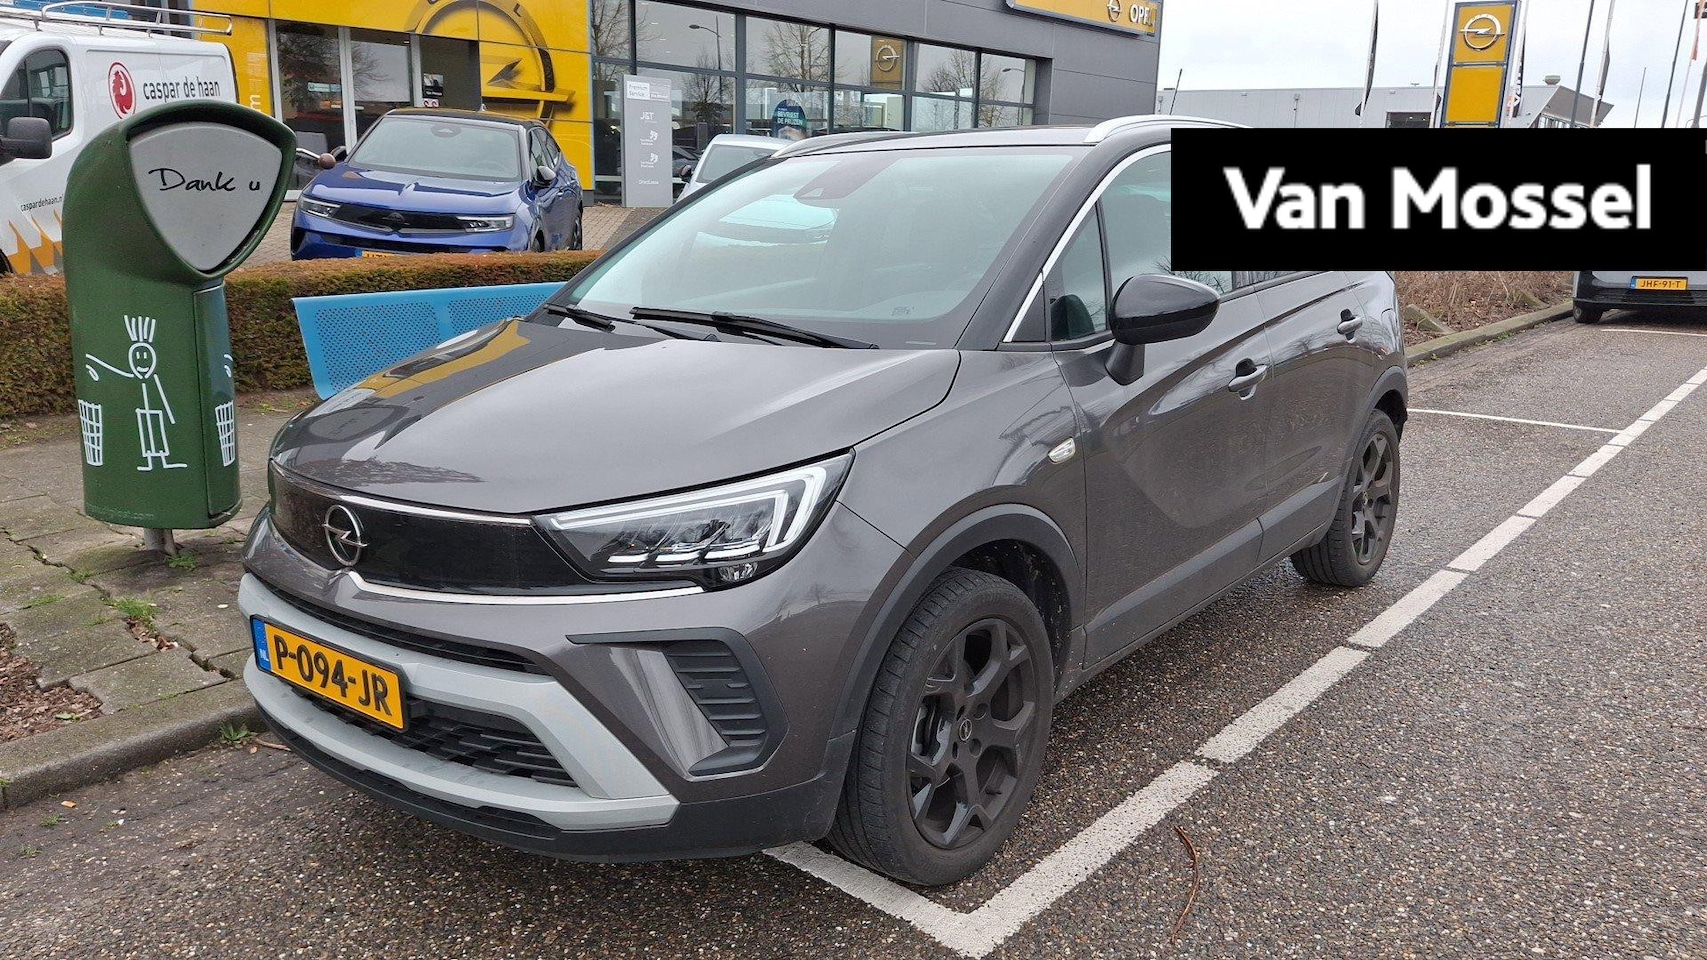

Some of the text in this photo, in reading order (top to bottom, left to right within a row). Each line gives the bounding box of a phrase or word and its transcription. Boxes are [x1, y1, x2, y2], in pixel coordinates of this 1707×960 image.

[143, 76, 221, 102] caspar de haan
[148, 168, 261, 191] Dank u
[1640, 280, 1681, 288] JHF-91-T
[273, 634, 392, 717] P-094-JR
